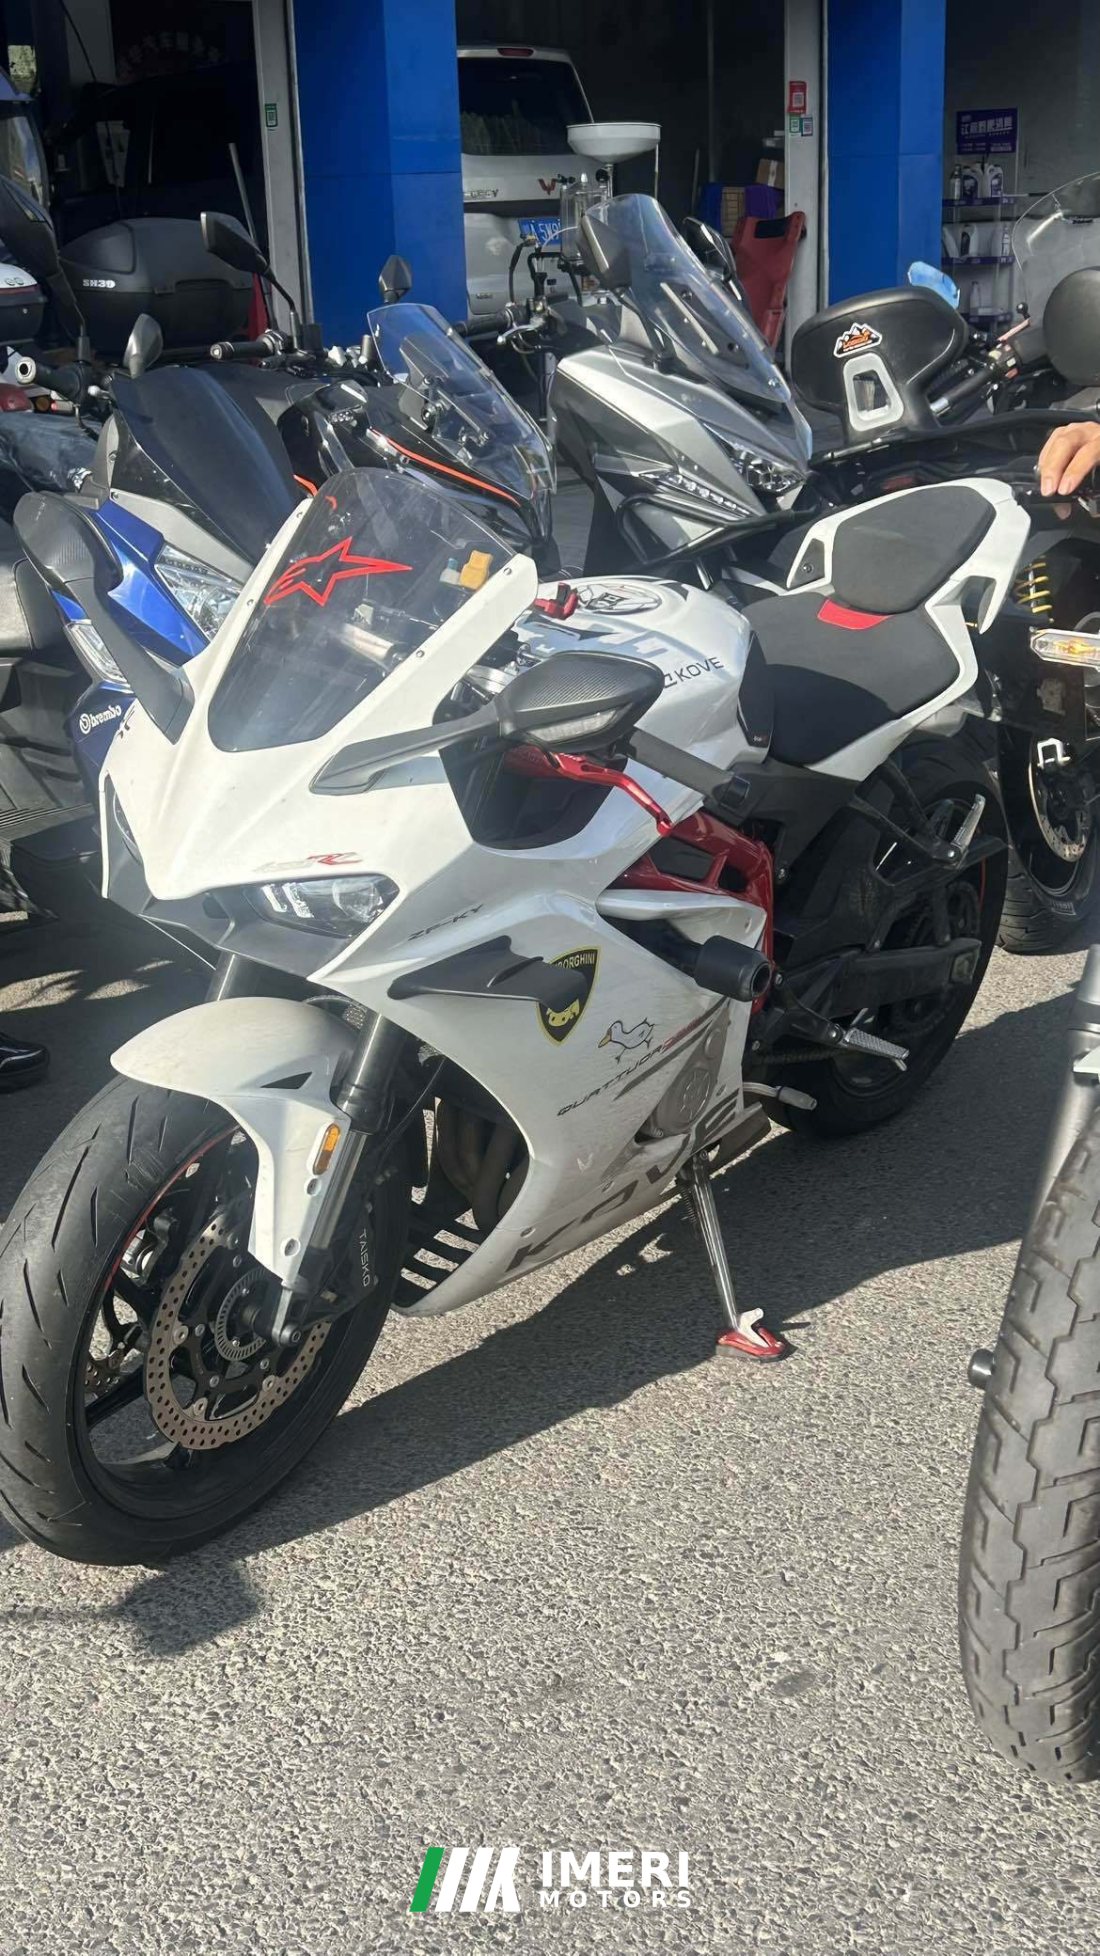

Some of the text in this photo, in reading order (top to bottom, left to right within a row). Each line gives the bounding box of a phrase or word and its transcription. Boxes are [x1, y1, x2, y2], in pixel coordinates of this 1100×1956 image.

[676, 656, 725, 683] KOVE
[89, 704, 122, 728] brembo
[360, 1227, 371, 1287] TAISKO
